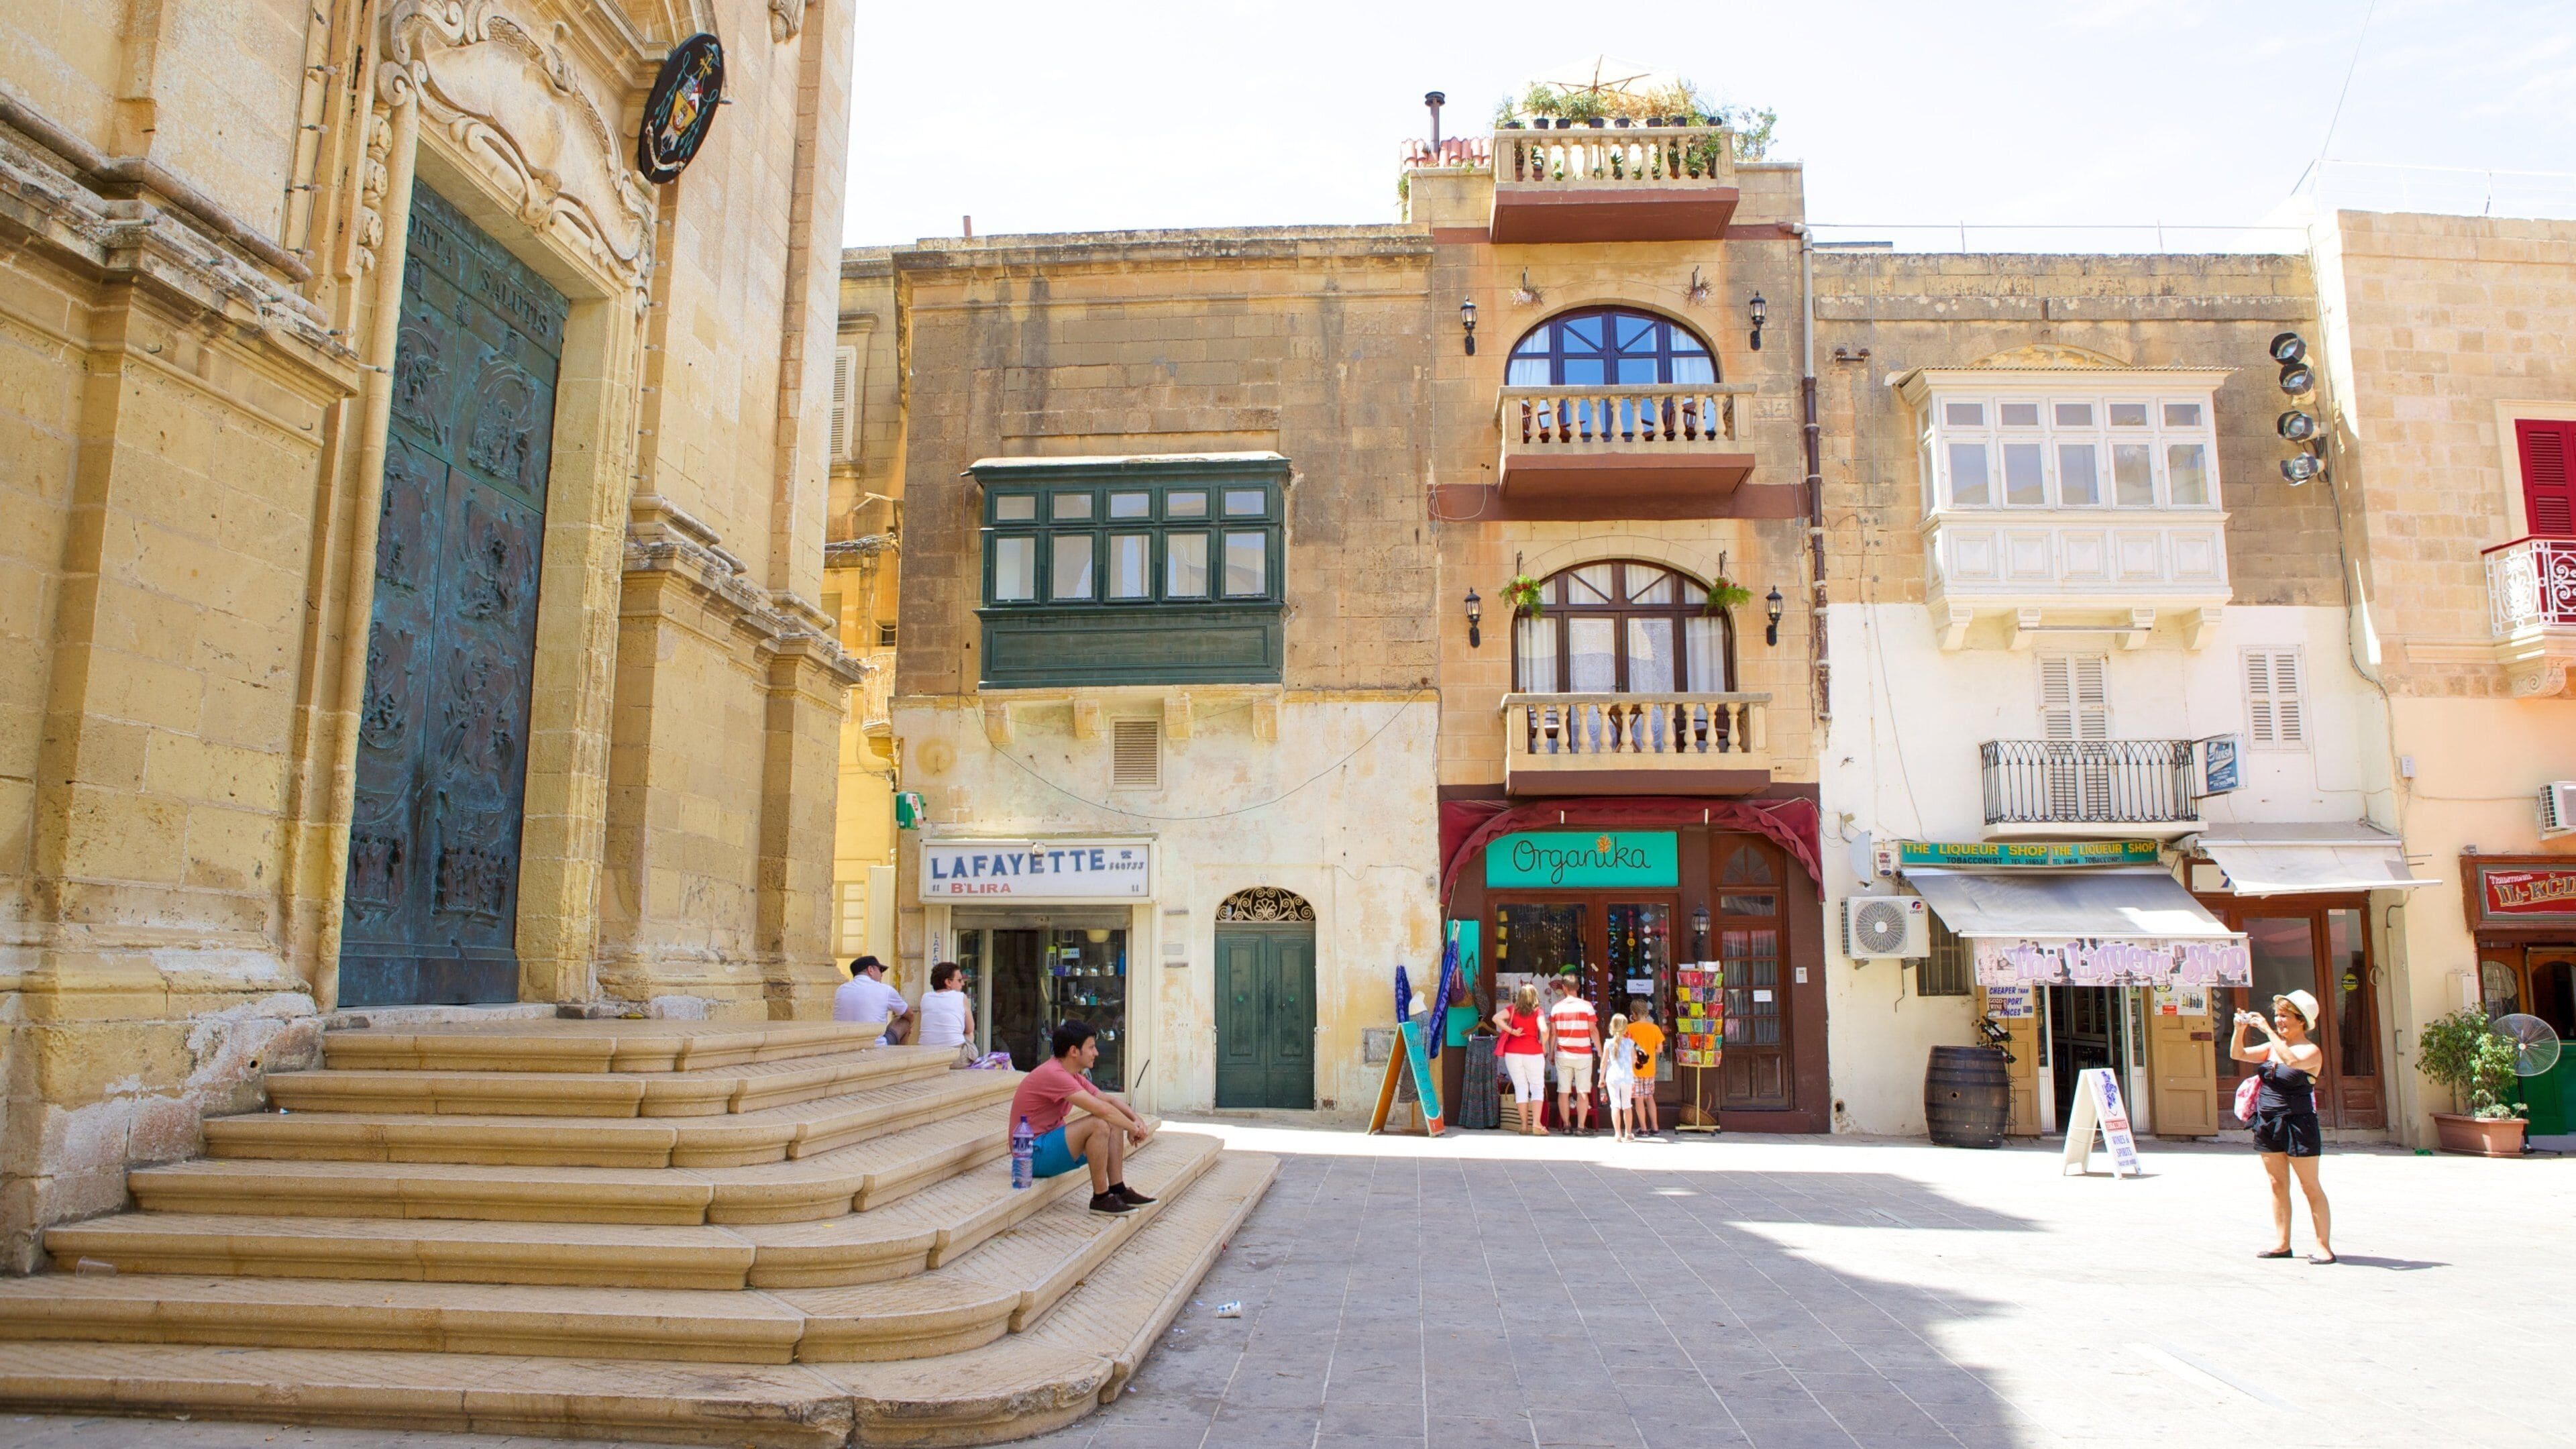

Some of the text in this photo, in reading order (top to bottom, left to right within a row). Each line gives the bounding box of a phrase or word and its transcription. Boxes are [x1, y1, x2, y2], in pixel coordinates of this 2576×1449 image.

[407, 213, 549, 335] ORTA SALUTIS
[1513, 836, 1652, 884] Organika
[1903, 843, 2047, 856] THE LIQUEUR SHOP
[2053, 842, 2156, 856] THE LIQUEUR SHOP
[2085, 856, 2125, 864] TOBACCONIST
[931, 849, 1106, 879] LAFAYETTE
[2004, 942, 2247, 983] The Liqueur Shop
[2000, 1008, 2021, 1016] PRICES
